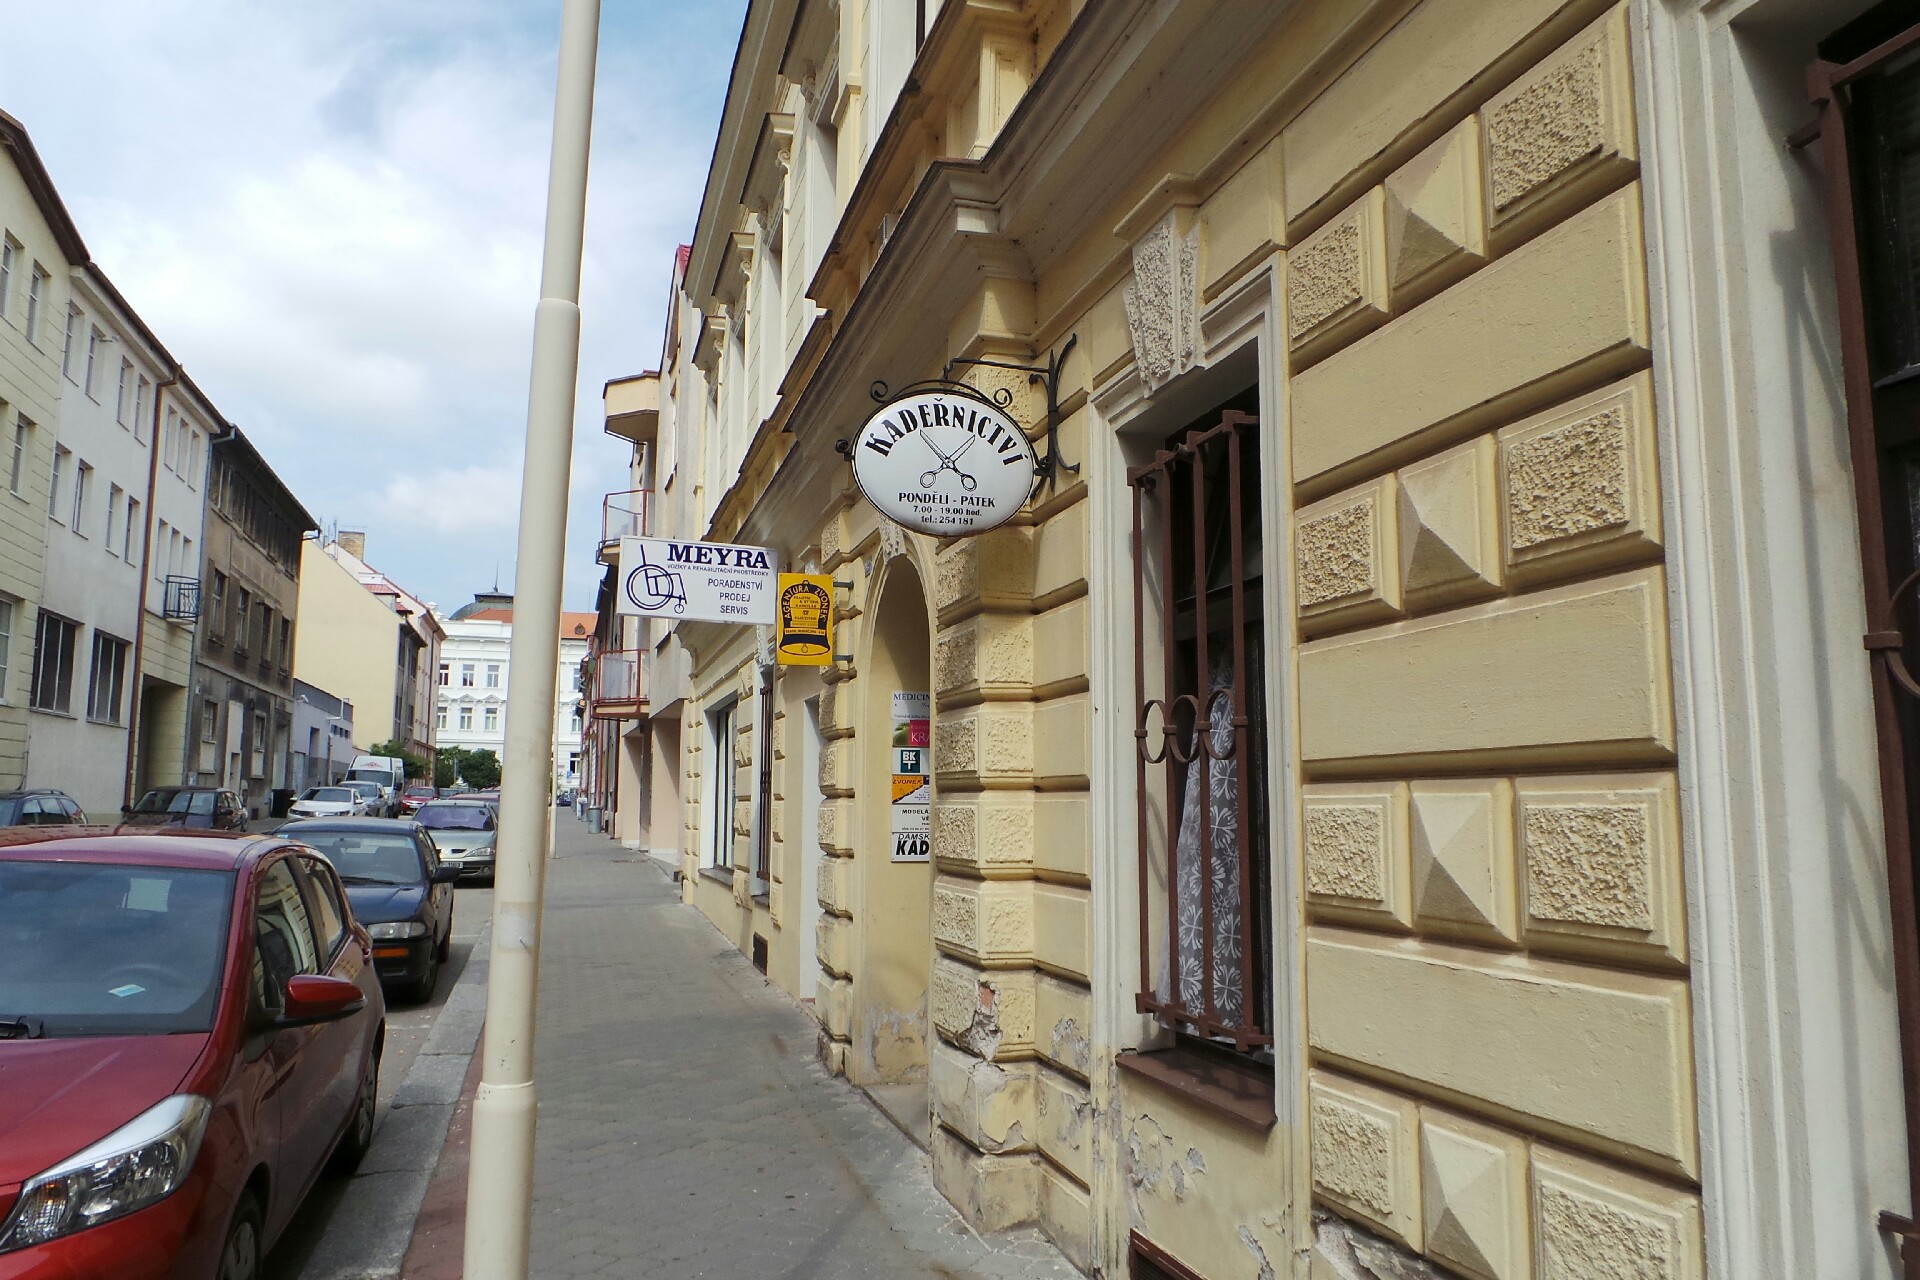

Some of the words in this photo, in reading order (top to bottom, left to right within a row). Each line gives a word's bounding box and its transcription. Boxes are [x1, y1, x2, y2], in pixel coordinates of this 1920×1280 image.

[865, 397, 1028, 465] KADEŘNICTVÍ
[899, 491, 950, 505] PONDĚLÍ
[961, 494, 996, 508] PÁTEK
[913, 505, 932, 513] 7.00
[940, 507, 964, 515] 19.00
[965, 508, 982, 516] hod.
[921, 515, 937, 524] tel.:
[939, 516, 956, 525] 254
[958, 517, 974, 525] 181
[667, 543, 770, 570] MEYRA
[693, 566, 733, 574] REHABILITAČNÍ
[733, 569, 769, 577] PROSTŘEDKY
[708, 578, 763, 591] PORADENSTVÍ
[720, 592, 751, 602] PRODEJ
[783, 585, 809, 619] AGENTURA
[814, 587, 829, 621] ZVONEK
[720, 605, 748, 615] SERVIS
[896, 840, 930, 856] KAD
